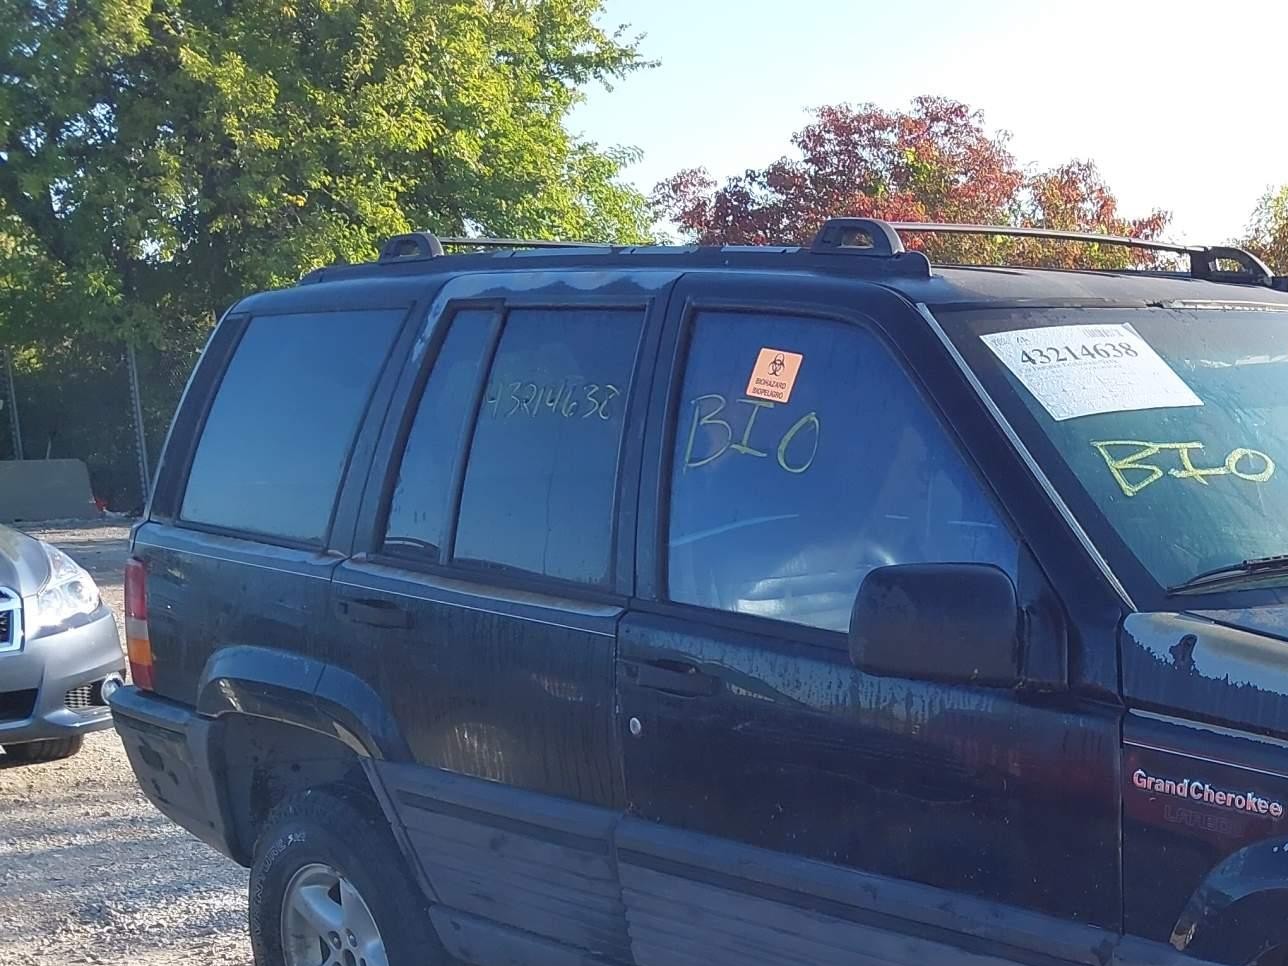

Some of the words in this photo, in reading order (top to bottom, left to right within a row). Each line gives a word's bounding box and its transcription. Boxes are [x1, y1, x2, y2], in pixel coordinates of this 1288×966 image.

[1020, 342, 1139, 366] 43214638
[755, 377, 787, 390] BIOHAZARD
[683, 394, 820, 474] BIO
[1090, 440, 1276, 496] BIO
